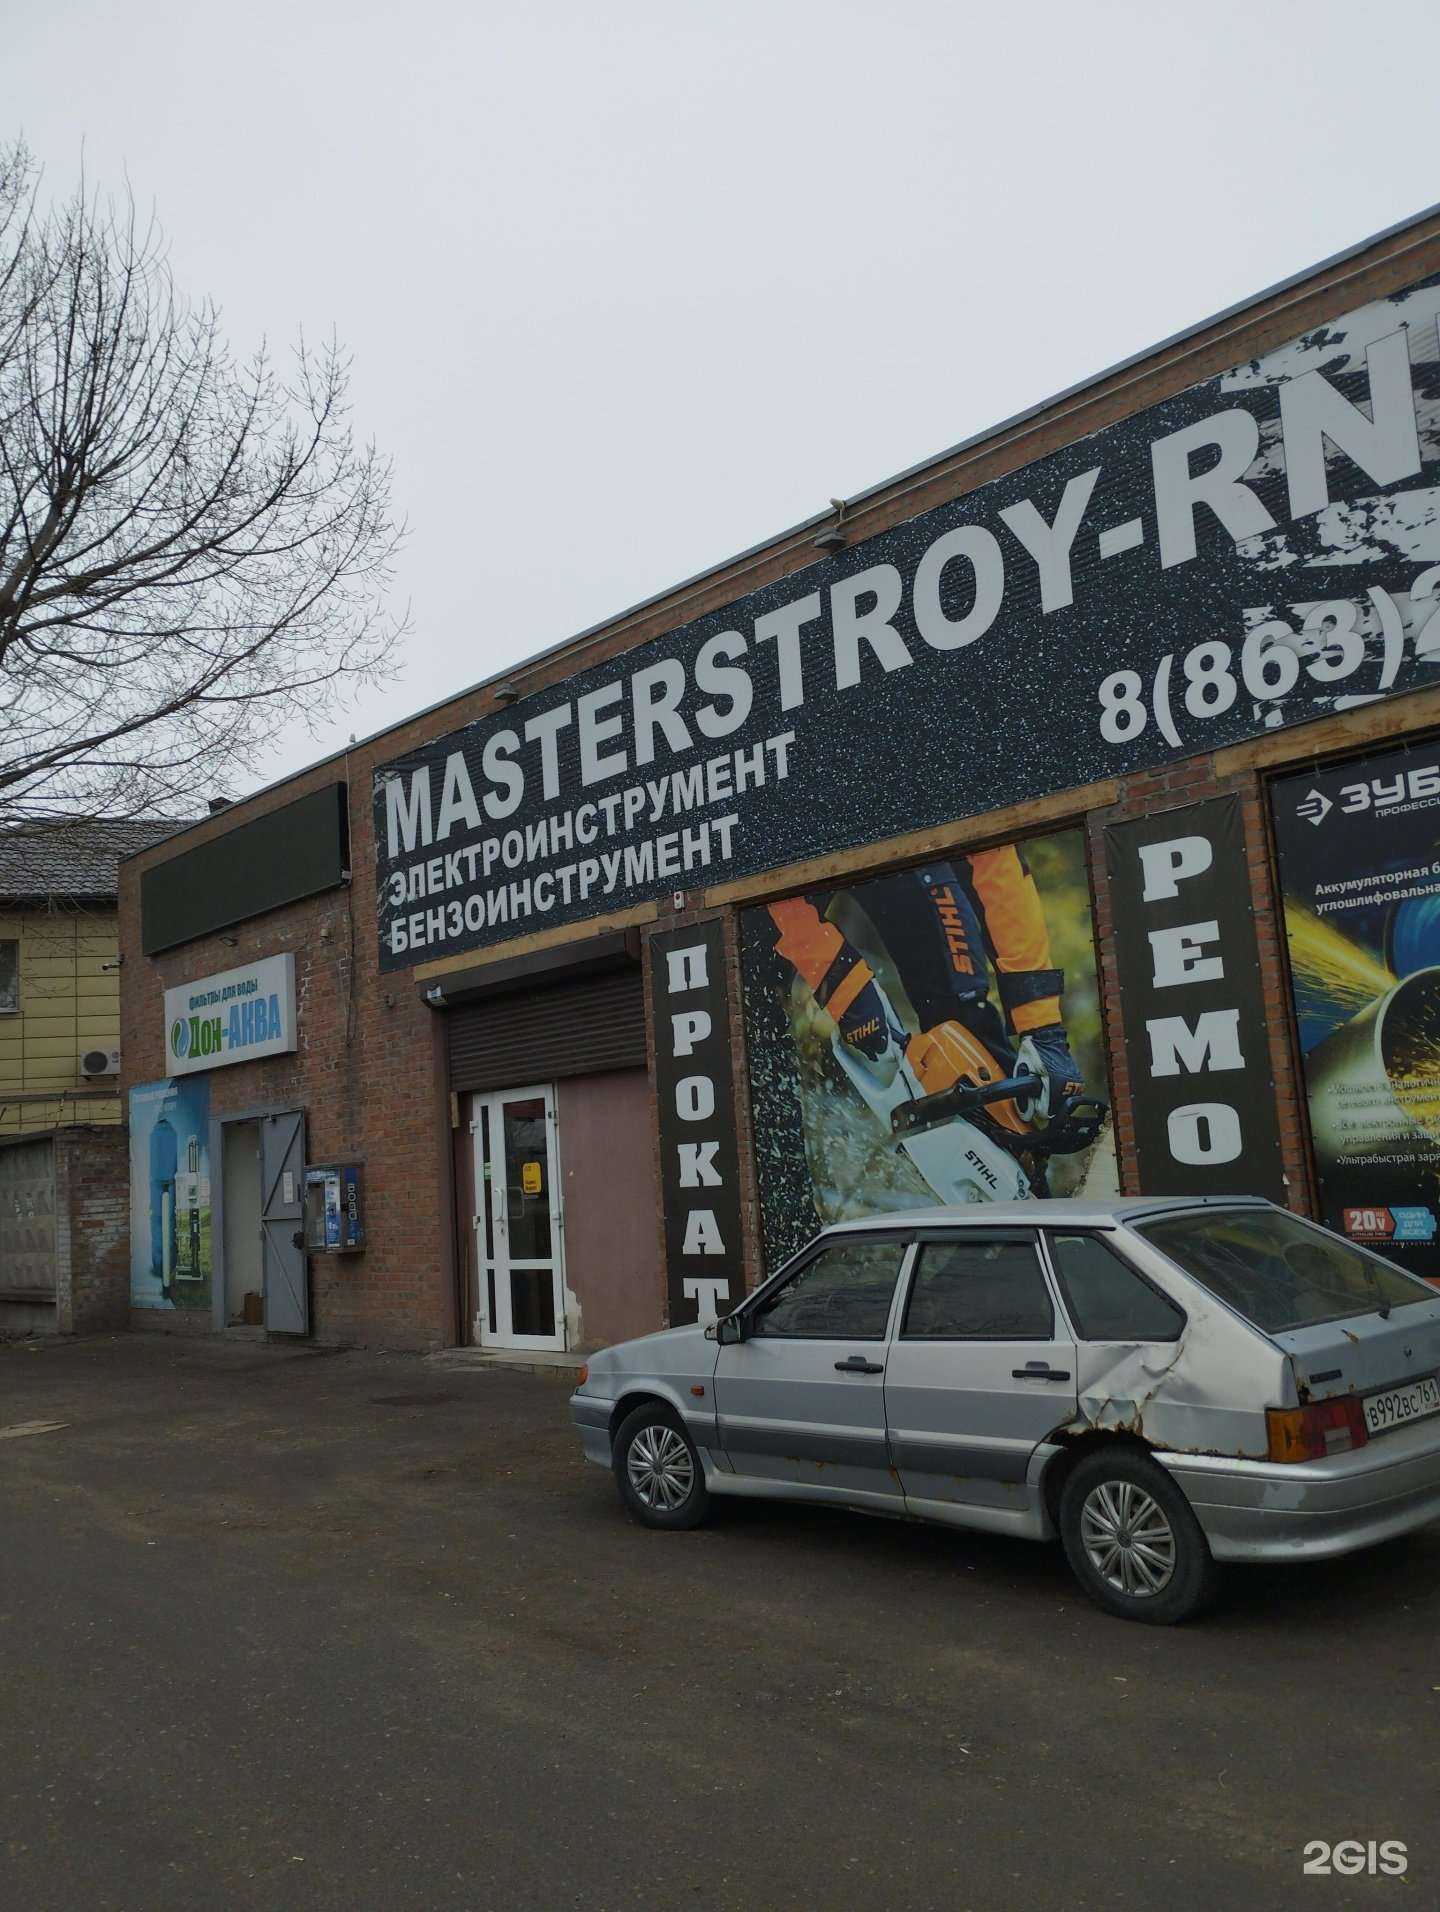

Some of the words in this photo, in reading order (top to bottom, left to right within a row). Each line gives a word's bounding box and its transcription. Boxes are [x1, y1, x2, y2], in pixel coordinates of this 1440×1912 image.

[385, 313, 1440, 858] MASTERSTROY-RN
[389, 731, 796, 905] ЭЛЕКТРОИНСТРУМЕНТ
[391, 814, 739, 955] БЕНЗОИНСТРУМЕНТ
[1315, 866, 1429, 896] Аккумуляторная
[1316, 882, 1440, 915] углошлифовальна
[935, 886, 975, 976] STIHL
[846, 1018, 880, 1043] STIHL
[1138, 836, 1245, 1165] РЕМО
[666, 943, 730, 1325] ПРОКАТ
[964, 1149, 998, 1190] STIHL
[1340, 1152, 1416, 1167] Ультрабыстрая
